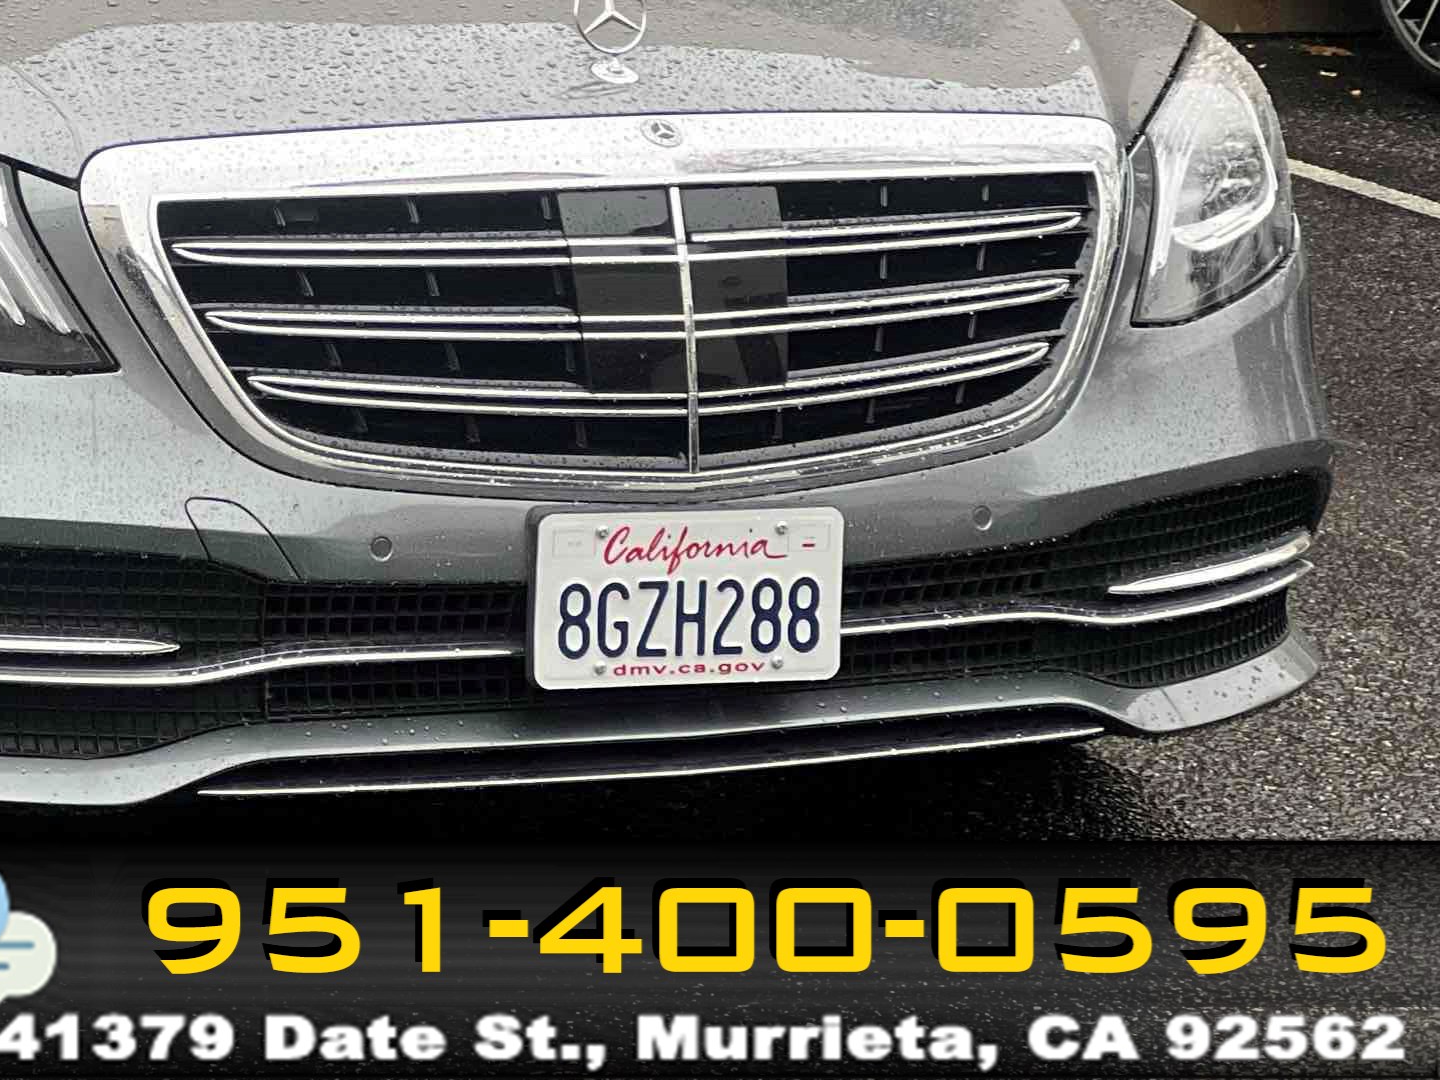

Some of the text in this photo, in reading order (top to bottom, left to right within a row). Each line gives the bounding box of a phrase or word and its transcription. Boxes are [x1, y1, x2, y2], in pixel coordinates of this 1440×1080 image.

[602, 525, 788, 576] California
[557, 576, 820, 660] 8GZH288
[613, 660, 766, 676] dmv.ca.gov
